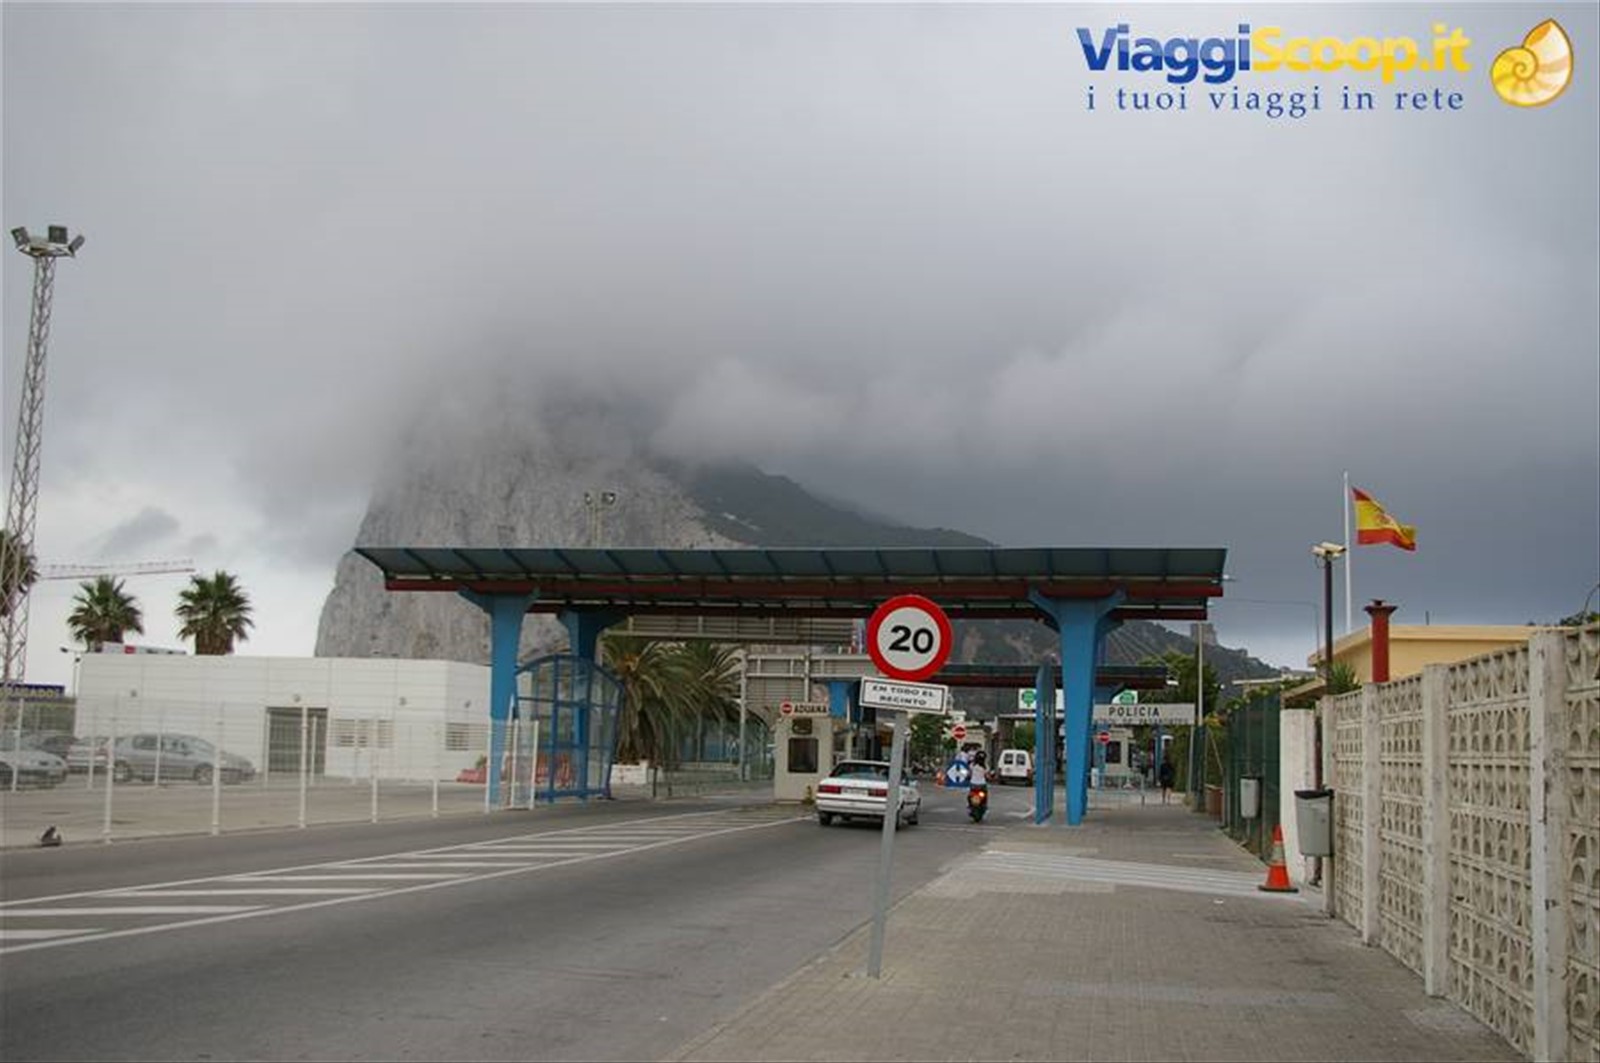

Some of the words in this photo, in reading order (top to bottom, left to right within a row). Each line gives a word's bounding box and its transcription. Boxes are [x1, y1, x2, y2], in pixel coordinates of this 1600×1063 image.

[888, 625, 934, 654] 20
[872, 684, 888, 692] EN
[890, 687, 920, 696] TODO
[879, 695, 927, 706] RECINTO
[793, 703, 827, 713] ADUANA
